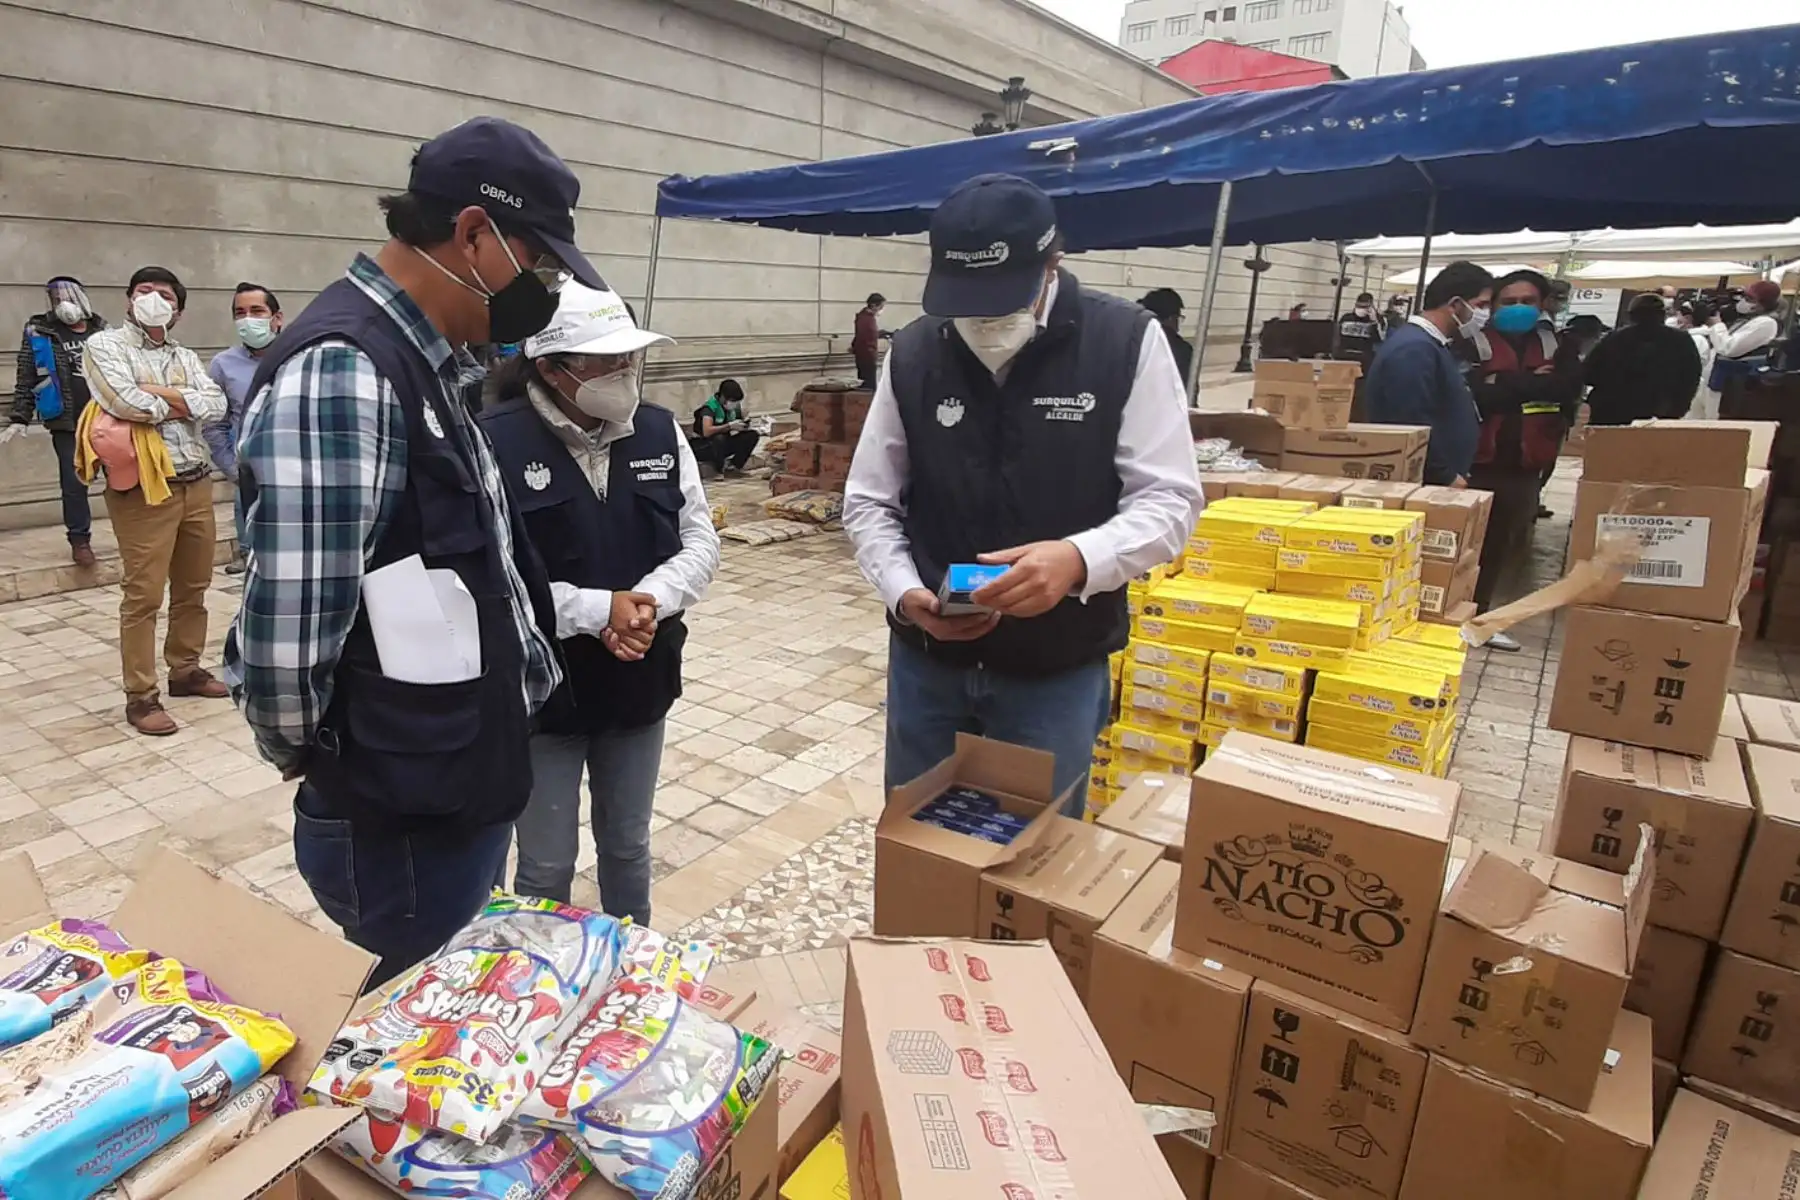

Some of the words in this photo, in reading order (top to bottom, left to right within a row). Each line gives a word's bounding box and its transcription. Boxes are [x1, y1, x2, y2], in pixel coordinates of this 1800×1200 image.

[480, 183, 523, 208] OBRAS
[1033, 392, 1096, 410] SURQUILLO
[1045, 411, 1084, 421] ALCALDE
[1268, 859, 1335, 897] TÍO
[1200, 856, 1405, 948] NACHO
[188, 1069, 227, 1100] QUAKER
[412, 1066, 461, 1081] BOLSITAS
[232, 1092, 255, 1112] 168
[256, 1087, 265, 1101] g
[458, 1072, 495, 1105] 35
[1706, 1137, 1724, 1160] LADO
